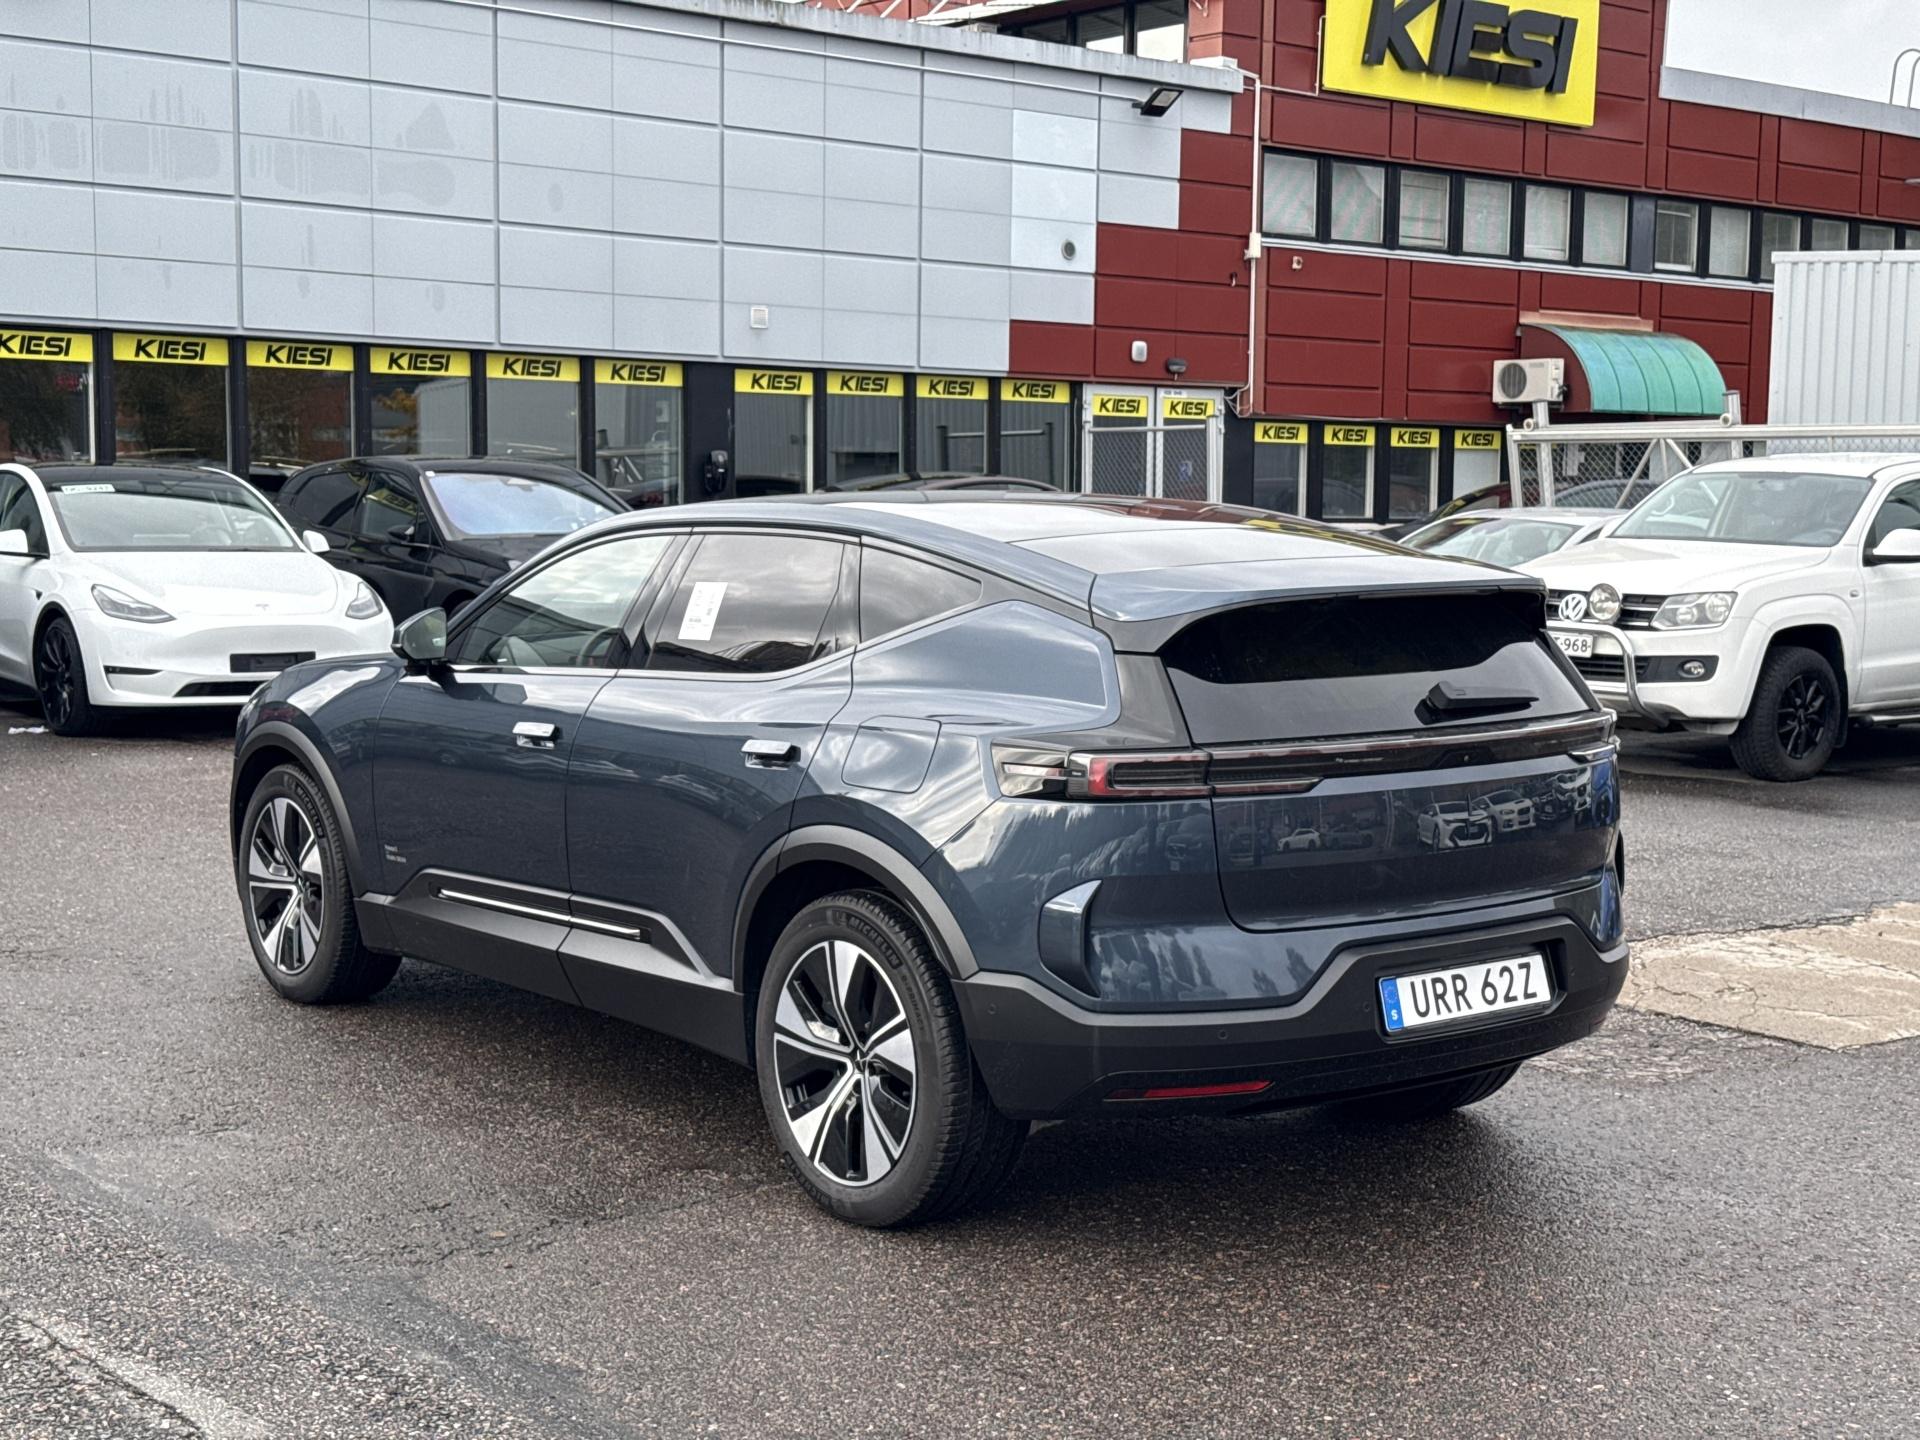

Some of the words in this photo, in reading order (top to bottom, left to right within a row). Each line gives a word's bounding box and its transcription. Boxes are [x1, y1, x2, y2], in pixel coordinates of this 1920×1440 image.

[1361, 0, 1579, 94] KIESI
[0, 333, 72, 357] KIESI
[134, 337, 208, 361] KIESI
[265, 344, 332, 367] KIESI
[387, 351, 450, 373] KIESI
[502, 357, 562, 378] KIESI
[610, 363, 666, 383] KIESI
[751, 373, 802, 391] KIESI
[839, 374, 889, 393] KIESI
[928, 378, 974, 397] KIESI
[1012, 380, 1056, 399] KIESI
[1099, 398, 1140, 413] KIESI
[1169, 400, 1208, 416] KIESI
[1262, 424, 1301, 440] KIESI
[1331, 427, 1369, 443] KIESI
[1397, 430, 1433, 446] KIESI
[1461, 431, 1495, 448] KIESI
[296, 786, 324, 837] MICHELIN
[848, 916, 901, 967] MICHELIN
[1410, 972, 1473, 1018] URR
[1481, 961, 1538, 1006] 62Z
[1391, 1010, 1398, 1020] S
